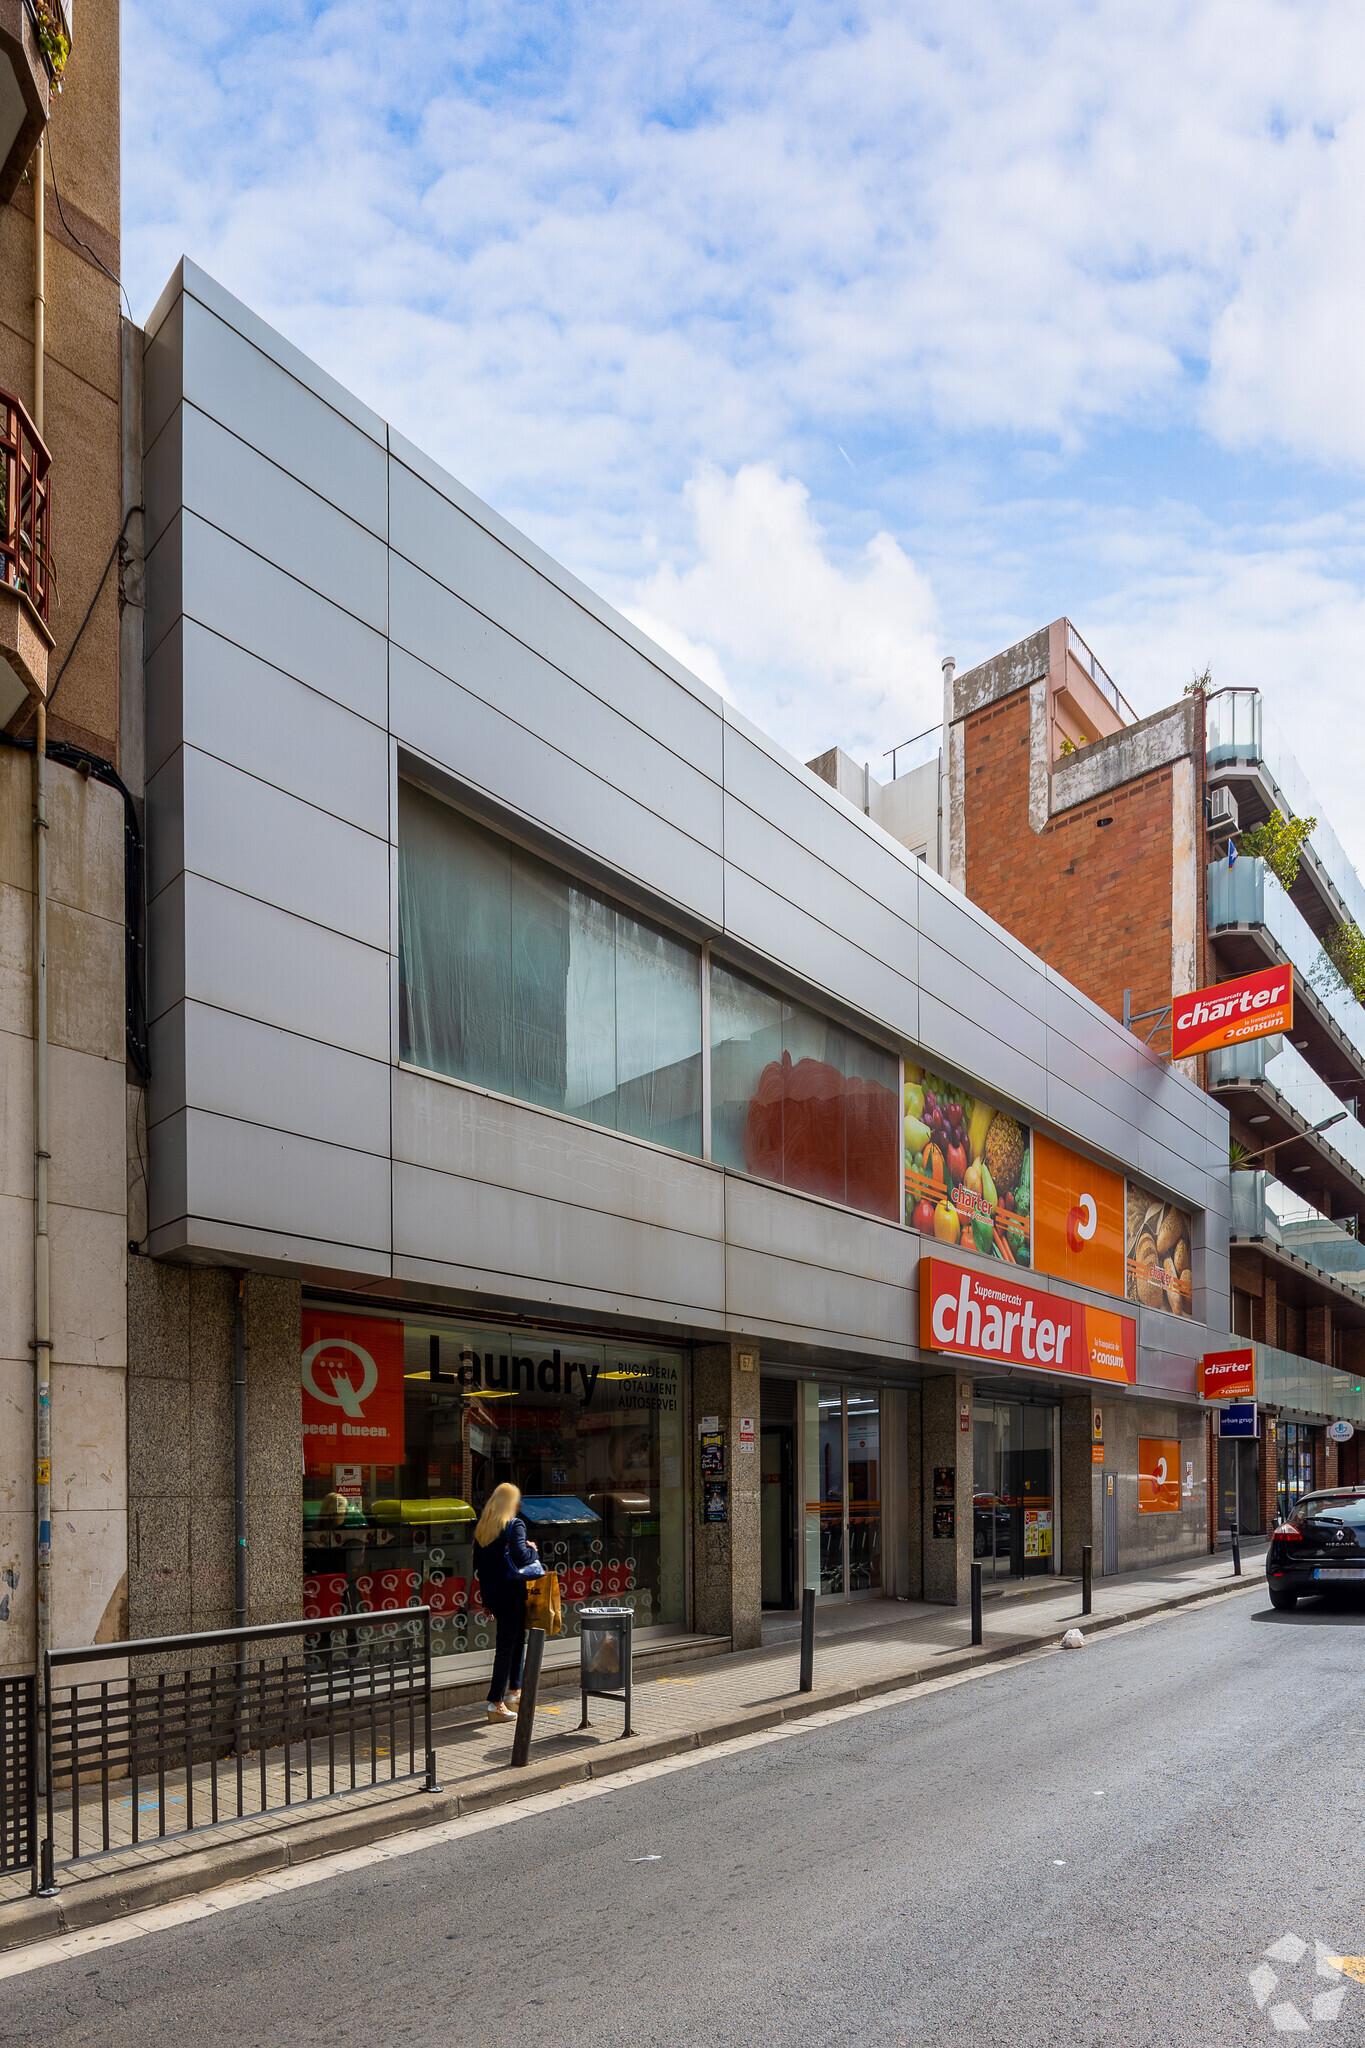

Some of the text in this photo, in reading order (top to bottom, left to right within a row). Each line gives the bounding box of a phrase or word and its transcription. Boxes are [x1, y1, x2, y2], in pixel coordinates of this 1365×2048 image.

[1176, 985, 1285, 1030] charter
[1235, 1016, 1285, 1037] consum
[951, 1183, 993, 1215] charter
[973, 1281, 1022, 1307] Supermercats
[932, 1274, 1071, 1364] charter
[742, 1357, 751, 1369] 67
[1097, 1351, 1124, 1368] consum
[1204, 1362, 1251, 1375] charter
[429, 1335, 600, 1406] Laundry
[618, 1362, 678, 1380] BUGADERIA
[618, 1379, 677, 1396] TOTALMENT
[618, 1395, 677, 1411] AUTOSERVEI
[302, 1422, 387, 1437] peed Queen
